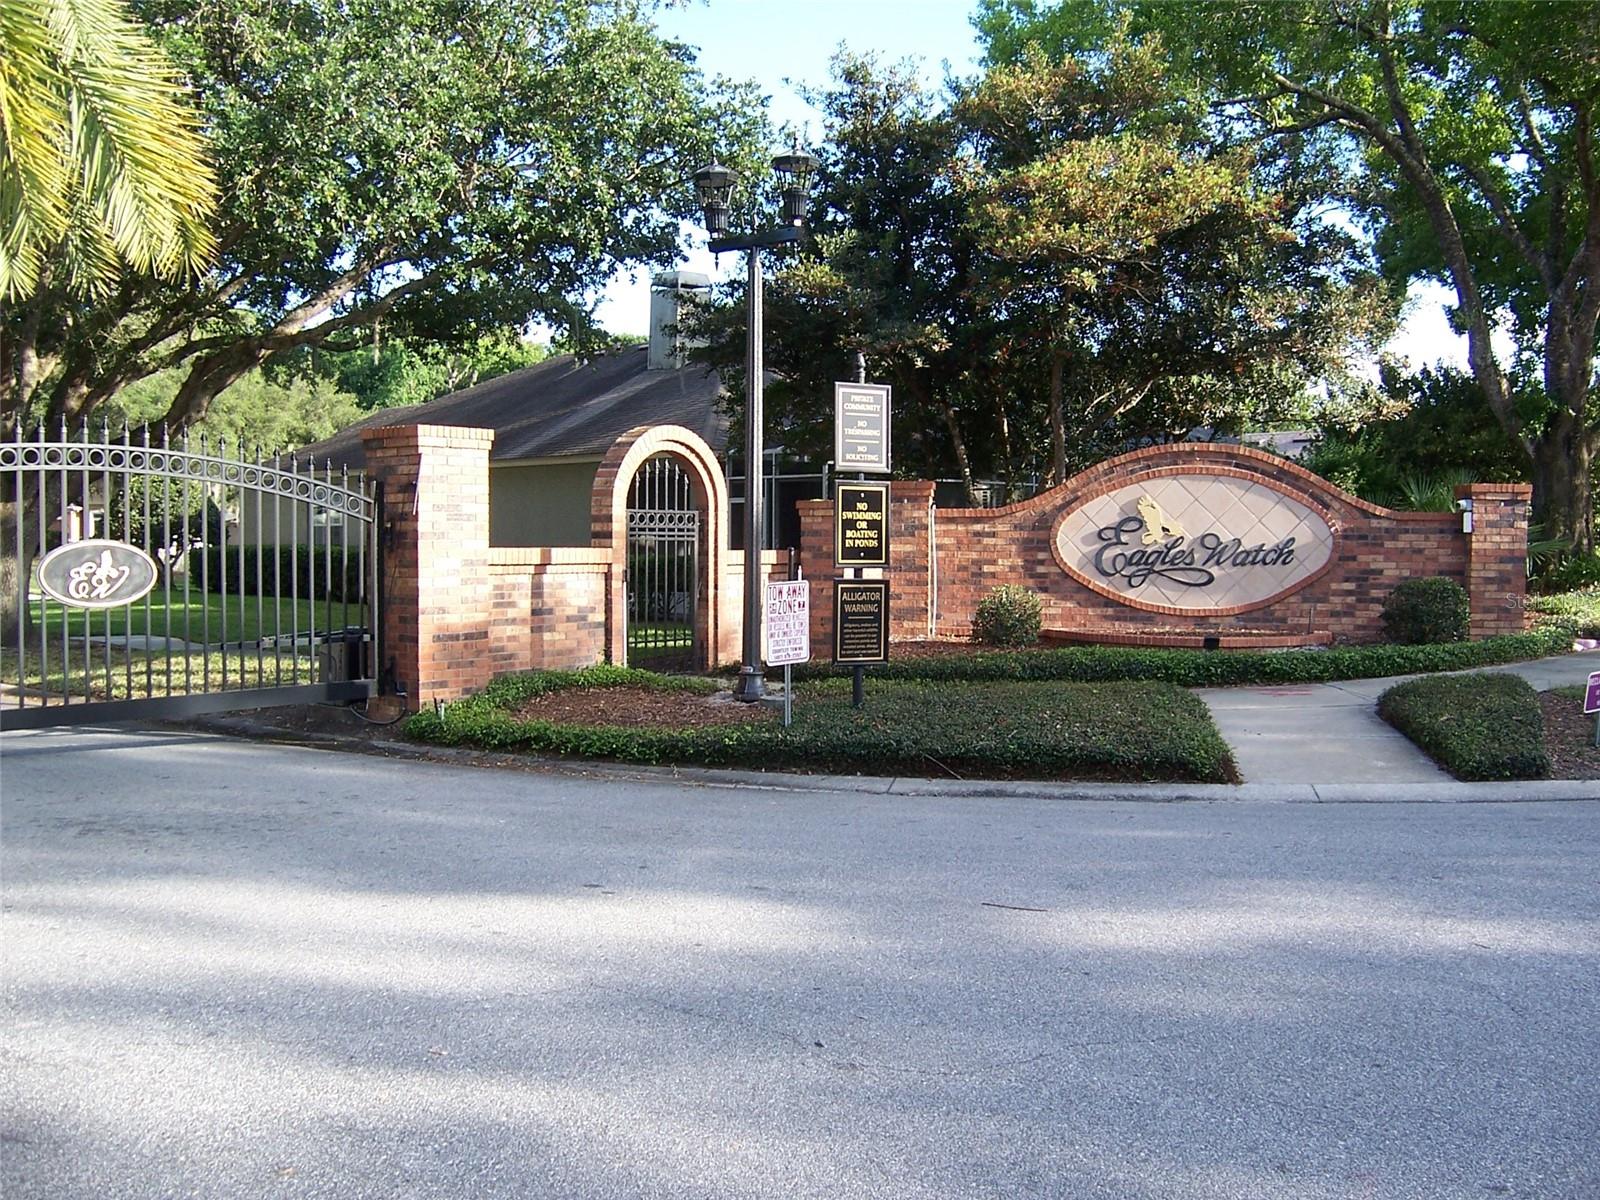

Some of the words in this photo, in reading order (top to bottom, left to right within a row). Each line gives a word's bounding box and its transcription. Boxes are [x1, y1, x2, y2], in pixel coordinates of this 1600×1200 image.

[844, 402, 881, 412] COMMUNITY
[857, 420, 868, 428] NO
[857, 445, 868, 453] NO
[845, 453, 879, 461] SOLICITING
[856, 502, 868, 511] NO
[842, 511, 882, 520] SWIMMING
[856, 521, 868, 529] OR
[845, 530, 878, 538] BOATING
[845, 539, 854, 548] IN
[854, 539, 879, 548] PONDS
[1094, 516, 1215, 588] Eagles
[1201, 533, 1296, 568] Watch
[768, 586, 784, 601] TOW
[786, 585, 806, 600] AWAY
[842, 591, 881, 601] ALLIGATOR
[777, 599, 797, 615] ZONE
[844, 604, 879, 613] WARNING
